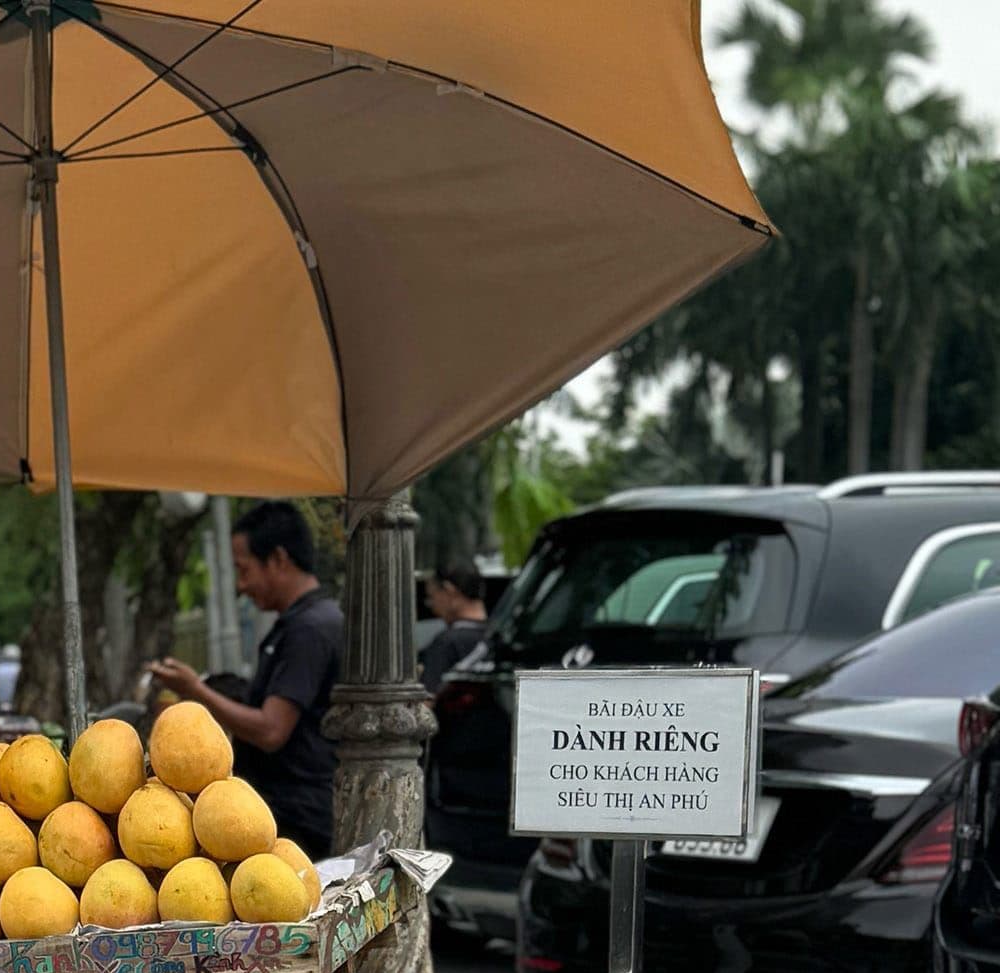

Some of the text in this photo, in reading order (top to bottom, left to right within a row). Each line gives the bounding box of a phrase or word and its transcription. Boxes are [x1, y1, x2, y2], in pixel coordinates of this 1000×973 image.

[588, 699, 685, 719] BÃI ĐẬU XE
[552, 724, 720, 752] DÀNH RIÊNG
[549, 762, 719, 783] CHO KHÁCH HÀNG
[558, 787, 709, 812] SIÊU THỊ AN PHÚ
